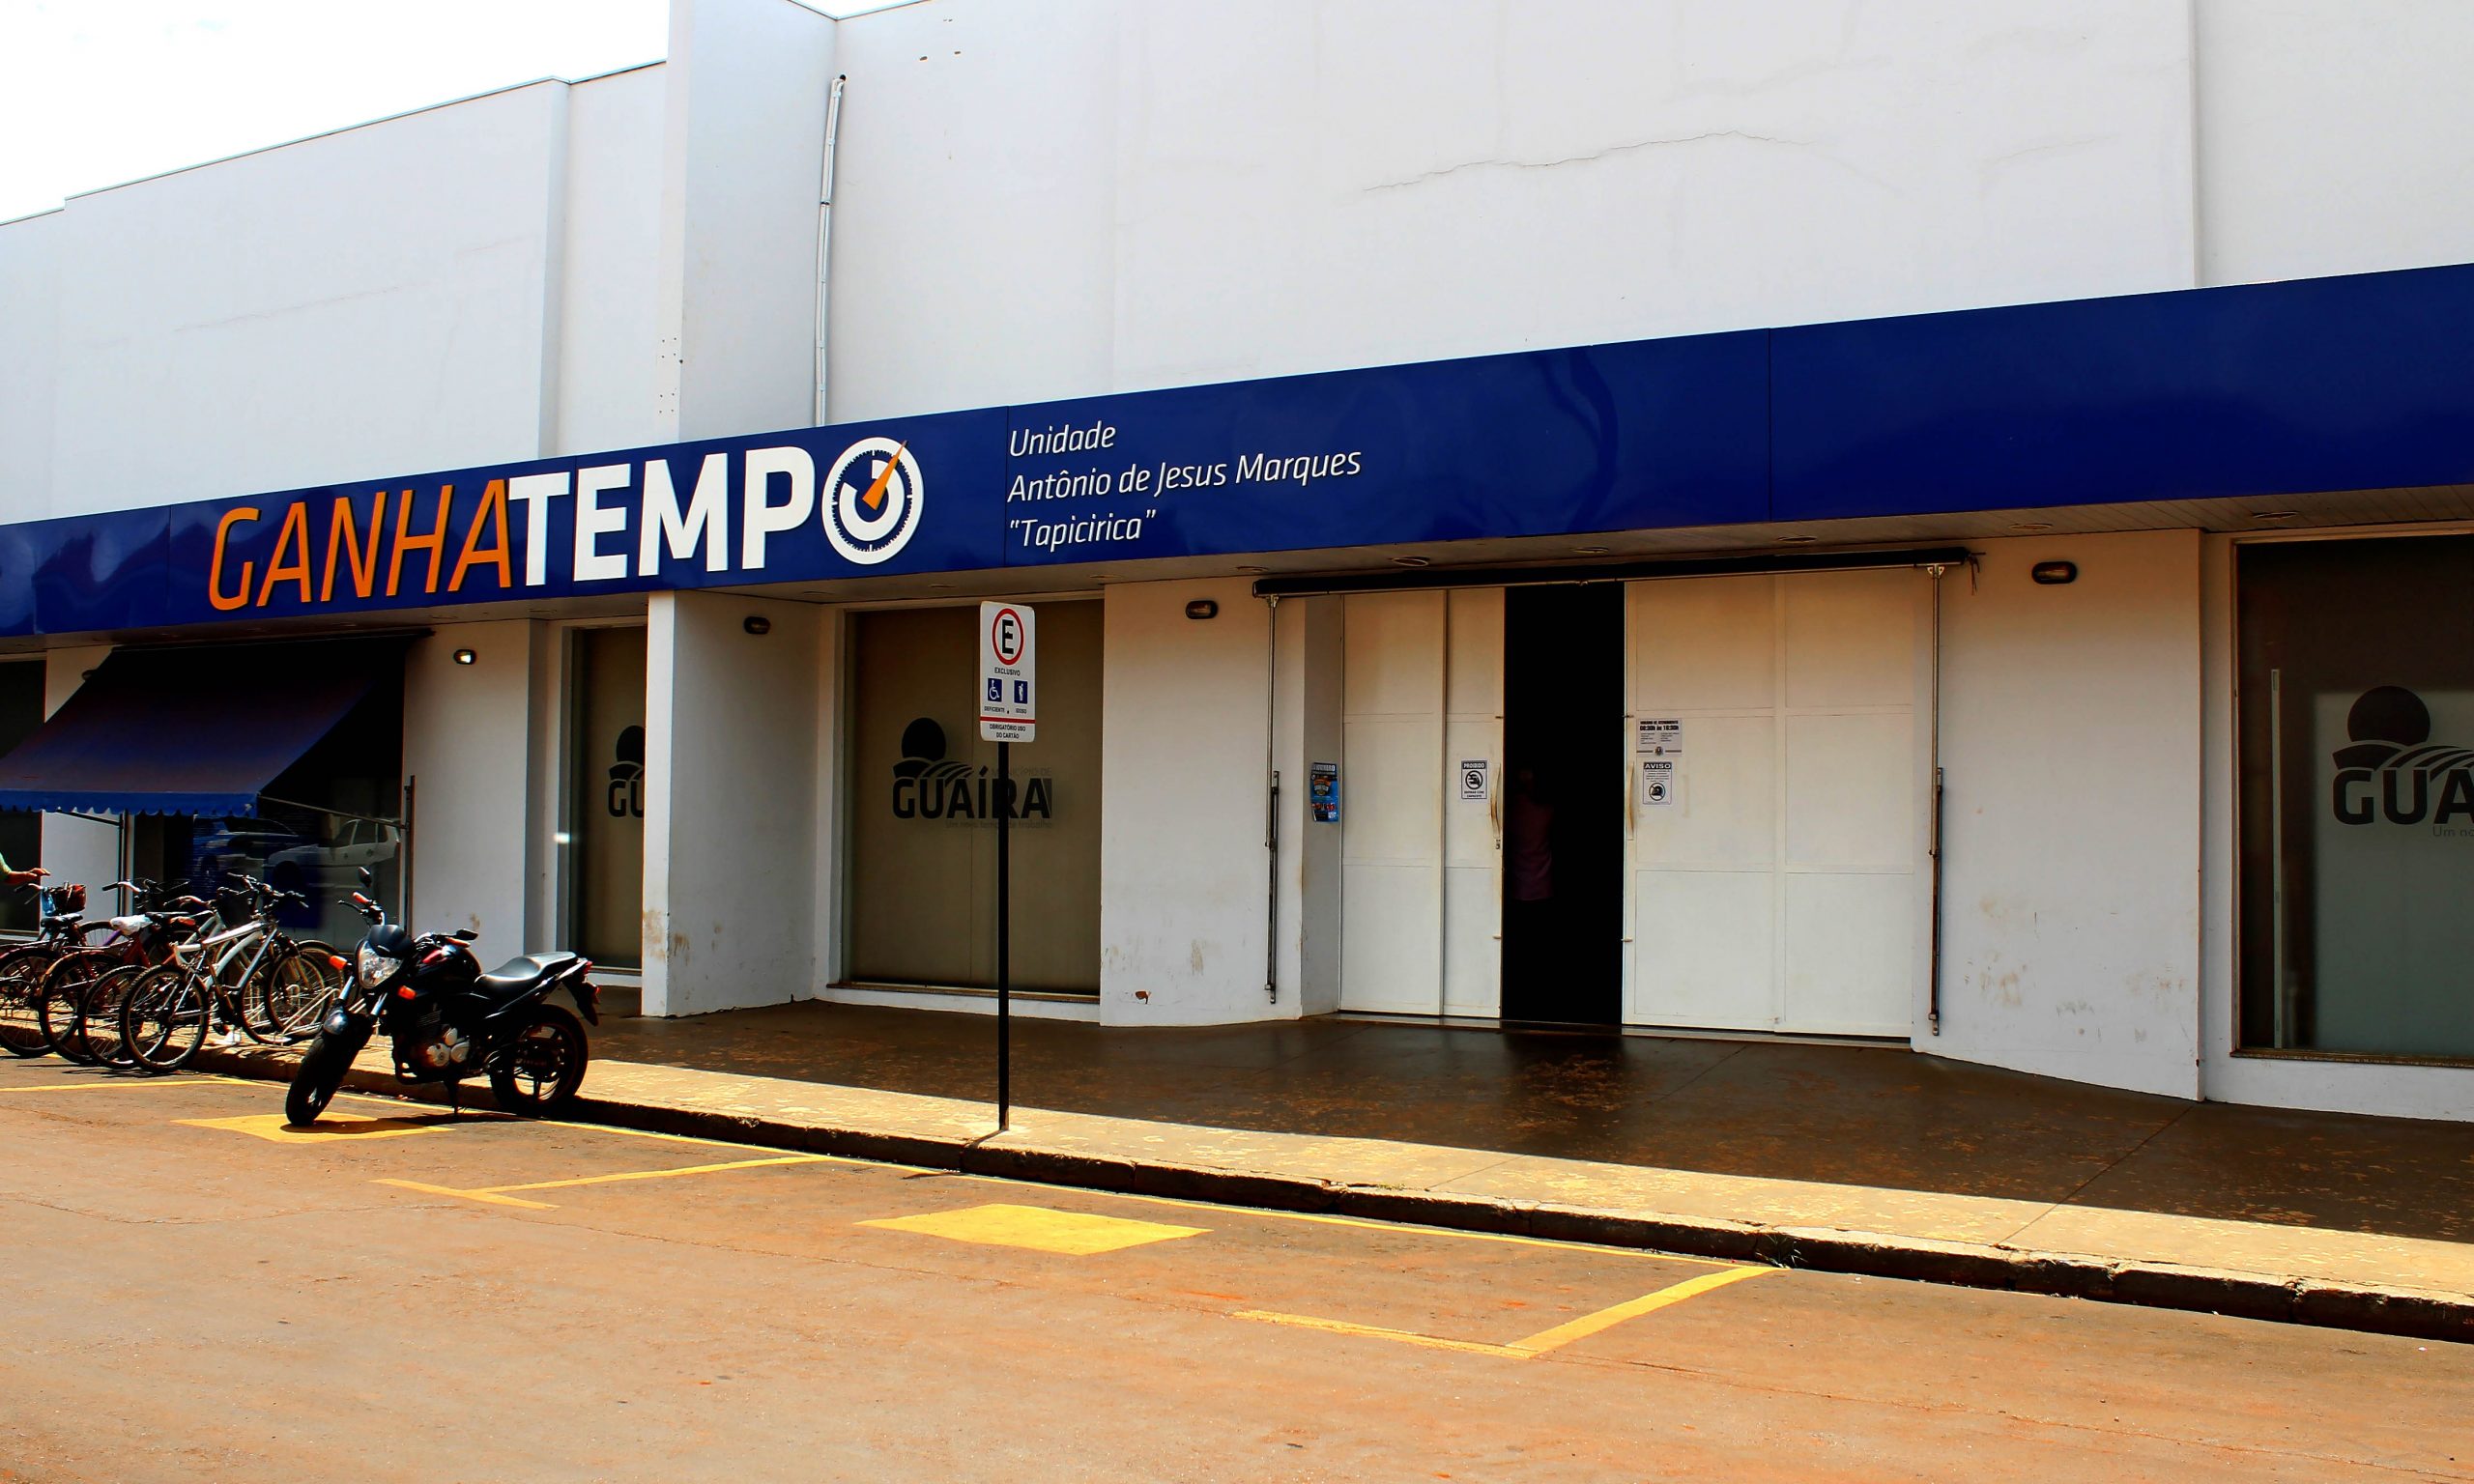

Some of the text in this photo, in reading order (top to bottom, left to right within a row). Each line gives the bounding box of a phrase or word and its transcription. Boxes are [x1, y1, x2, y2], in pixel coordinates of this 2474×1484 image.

[1009, 420, 1116, 457] Unidade
[1007, 450, 1362, 502] Antônio de Jesus Marques
[1002, 619, 1015, 654] E
[994, 667, 1021, 676] EXCLUSIVO
[893, 765, 1051, 819] GUAÍRA
